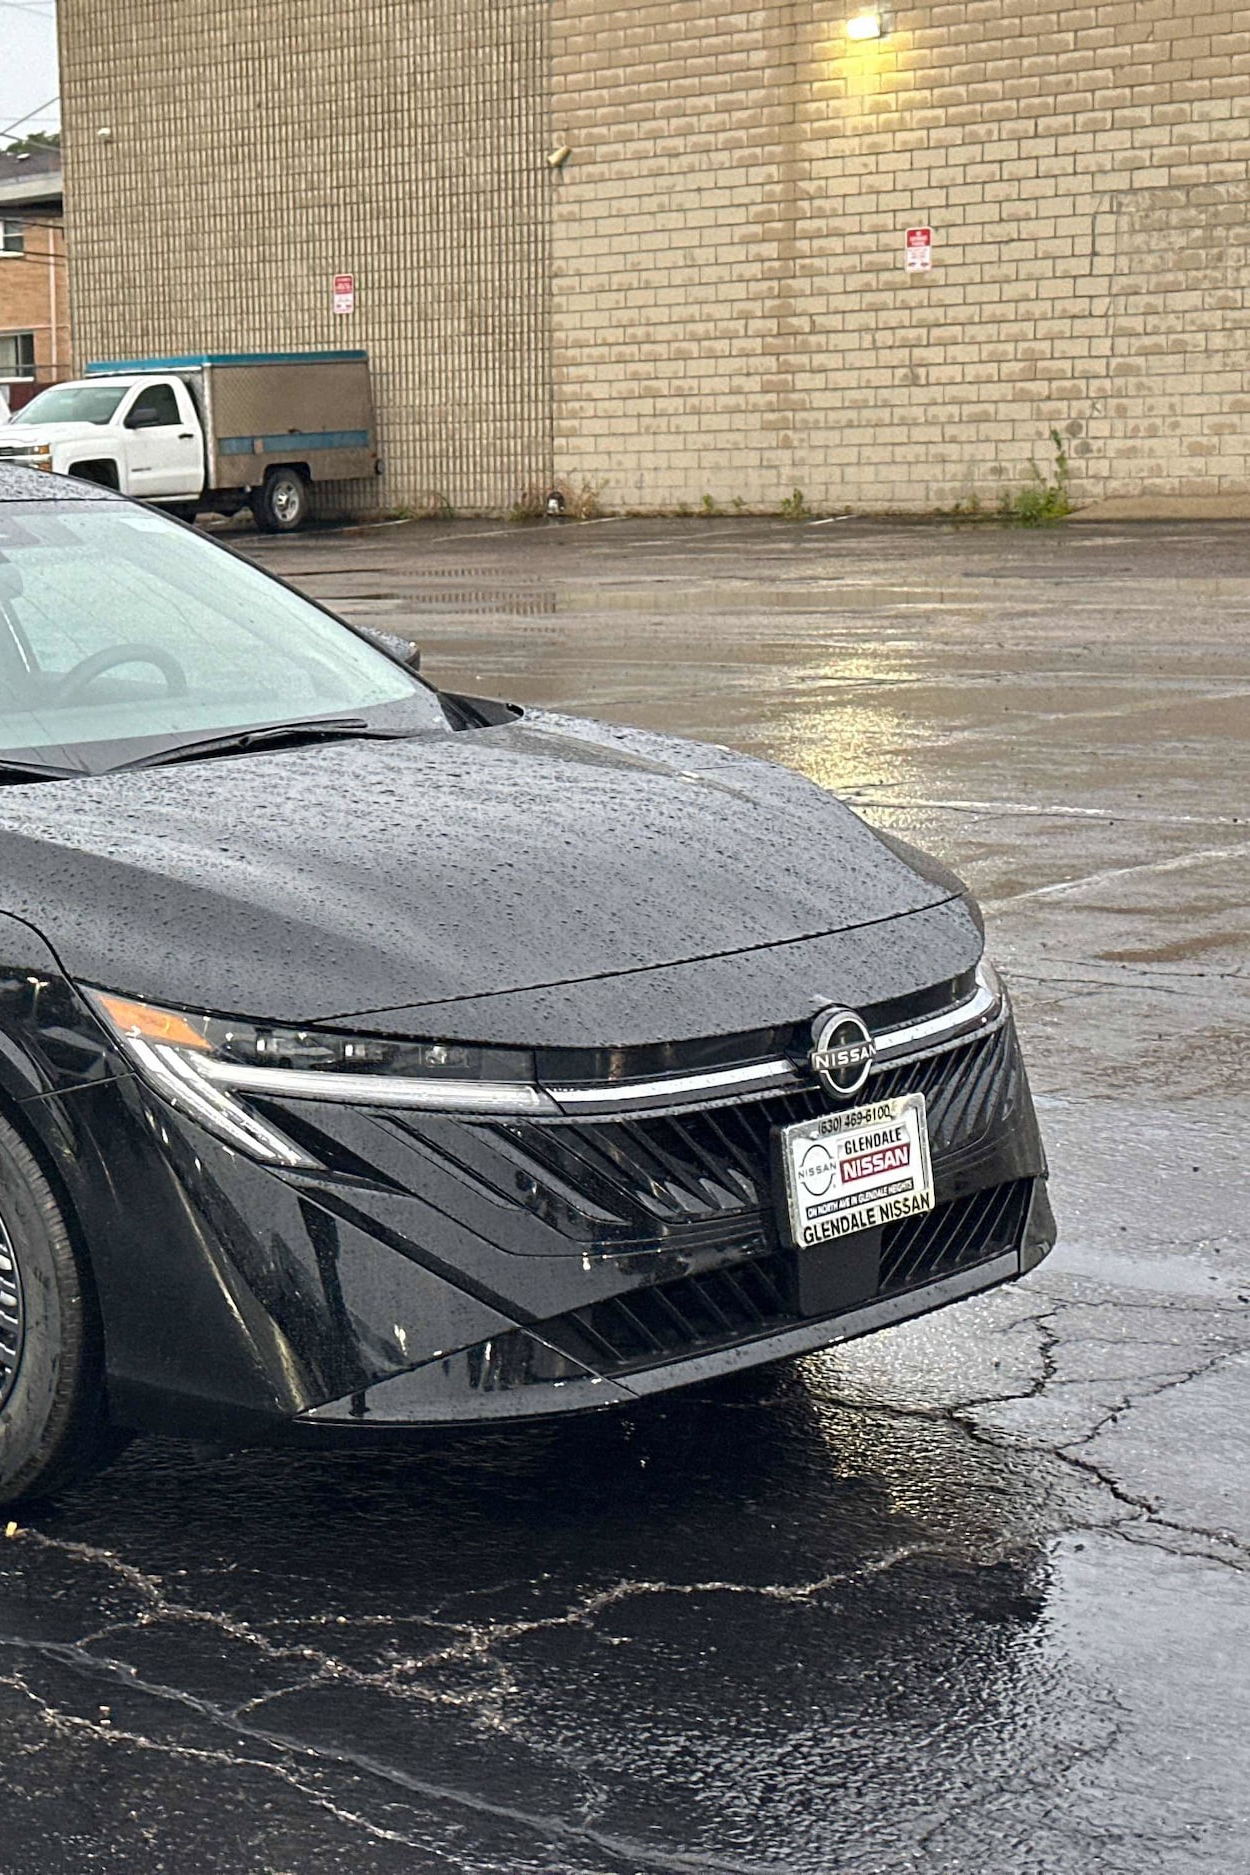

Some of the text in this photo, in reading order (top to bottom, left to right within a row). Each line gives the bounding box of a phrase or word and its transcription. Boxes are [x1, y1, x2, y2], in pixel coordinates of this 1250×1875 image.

[815, 1044, 877, 1069] NISSAN
[818, 1104, 891, 1135] (630) 469-6100
[844, 1127, 902, 1155] GLENDALE
[798, 1161, 837, 1180] NISSAN
[841, 1146, 909, 1181] NISSAN
[807, 1181, 913, 1218] ON NORTH AVE IN GLENDALE HEIGHTS
[803, 1191, 931, 1244] GLENDALE NISSAN
